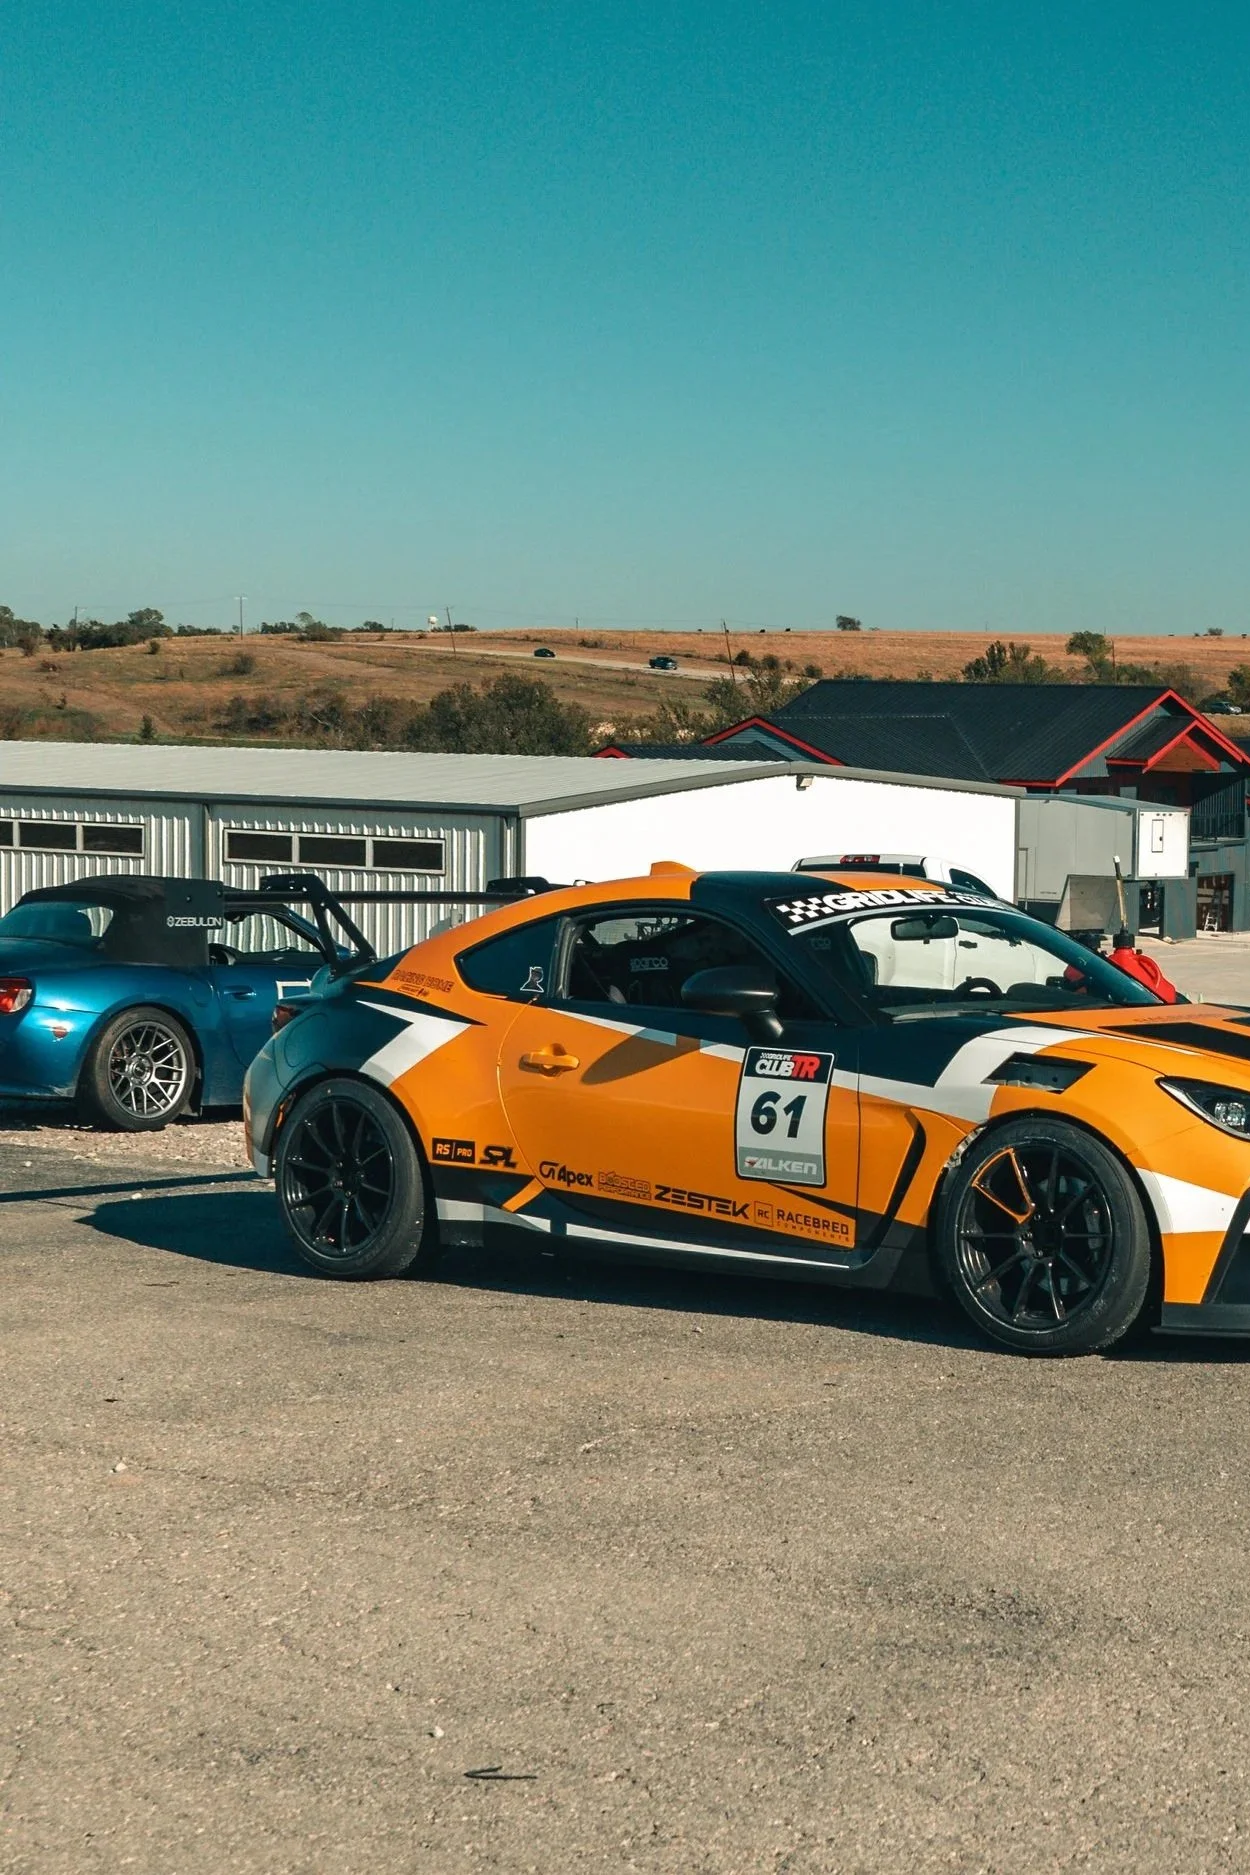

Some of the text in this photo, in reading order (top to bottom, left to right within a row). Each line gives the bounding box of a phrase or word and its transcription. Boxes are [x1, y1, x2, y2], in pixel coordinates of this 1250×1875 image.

[823, 889, 959, 910] GRIDLIFE
[174, 916, 222, 927] ZEBULON
[751, 1091, 807, 1138] 61
[436, 1143, 473, 1157] RS PRO
[654, 1184, 750, 1220] ZESTEK
[757, 1208, 770, 1220] RC
[777, 1209, 849, 1235] RACEBRED
